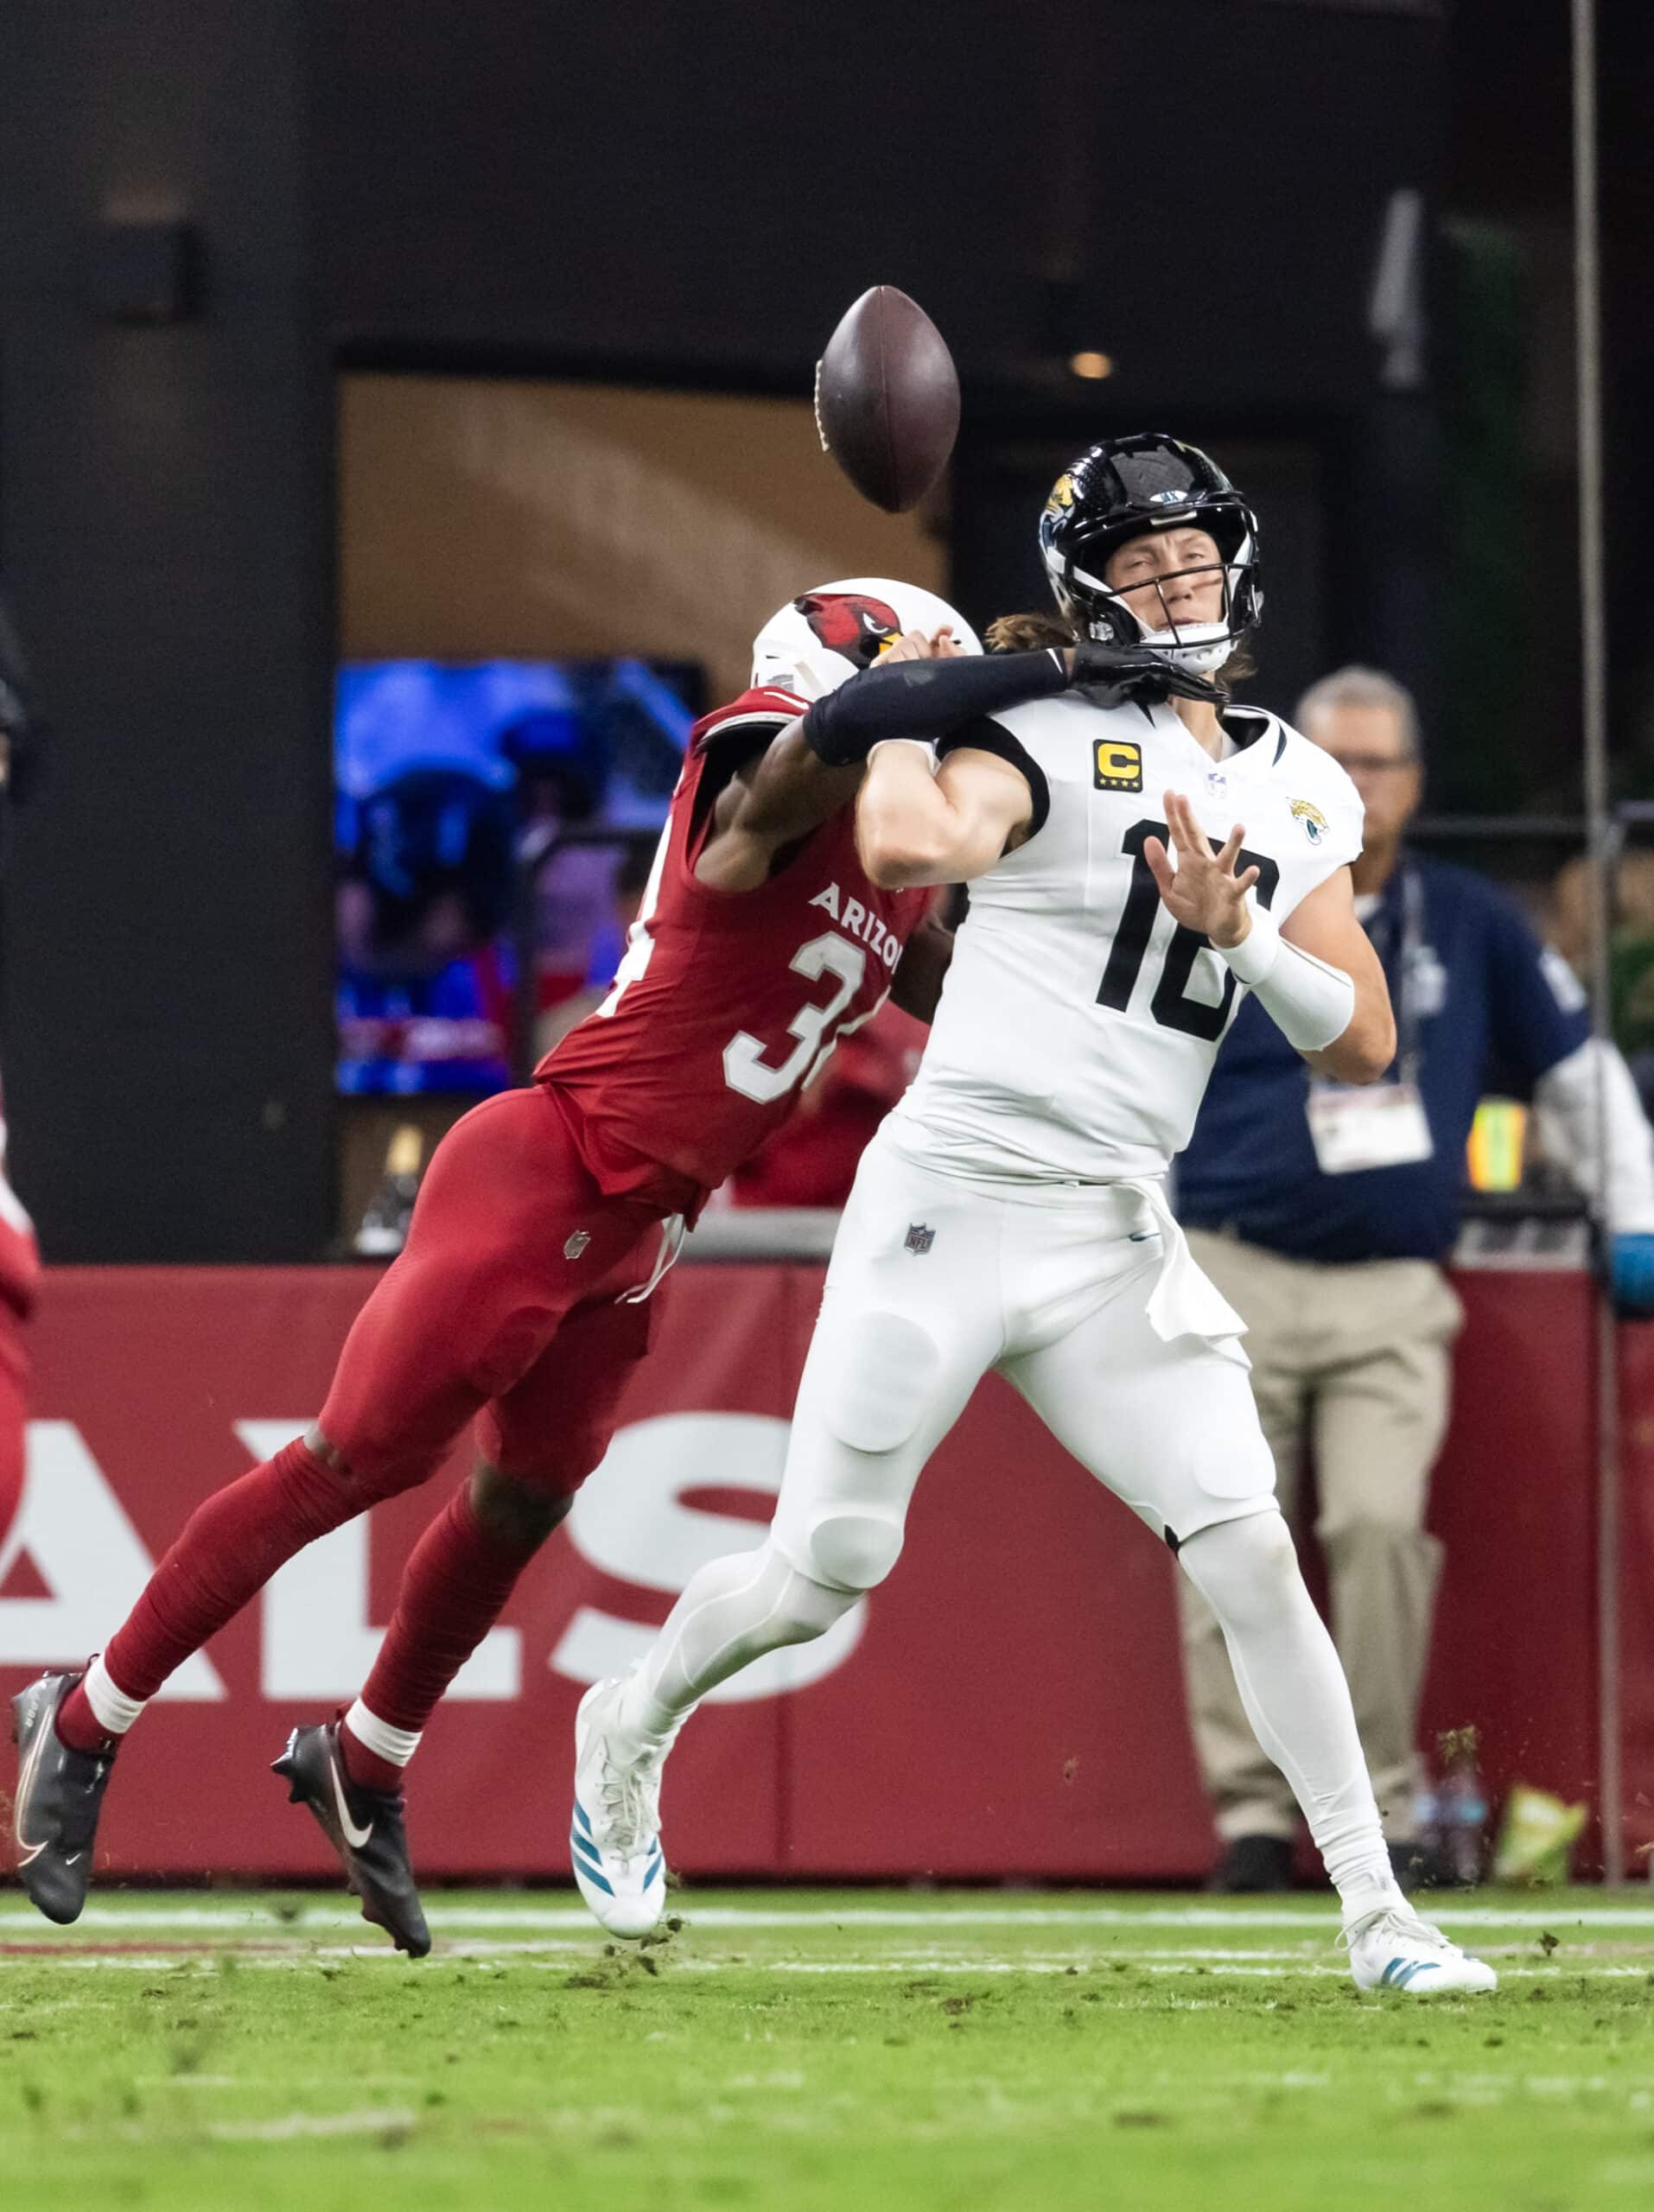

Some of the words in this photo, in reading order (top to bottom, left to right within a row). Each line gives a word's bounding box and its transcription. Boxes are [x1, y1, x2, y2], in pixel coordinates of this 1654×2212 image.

[1097, 743, 1139, 779] C
[807, 881, 903, 975] ARIZO
[723, 931, 891, 1103] 3
